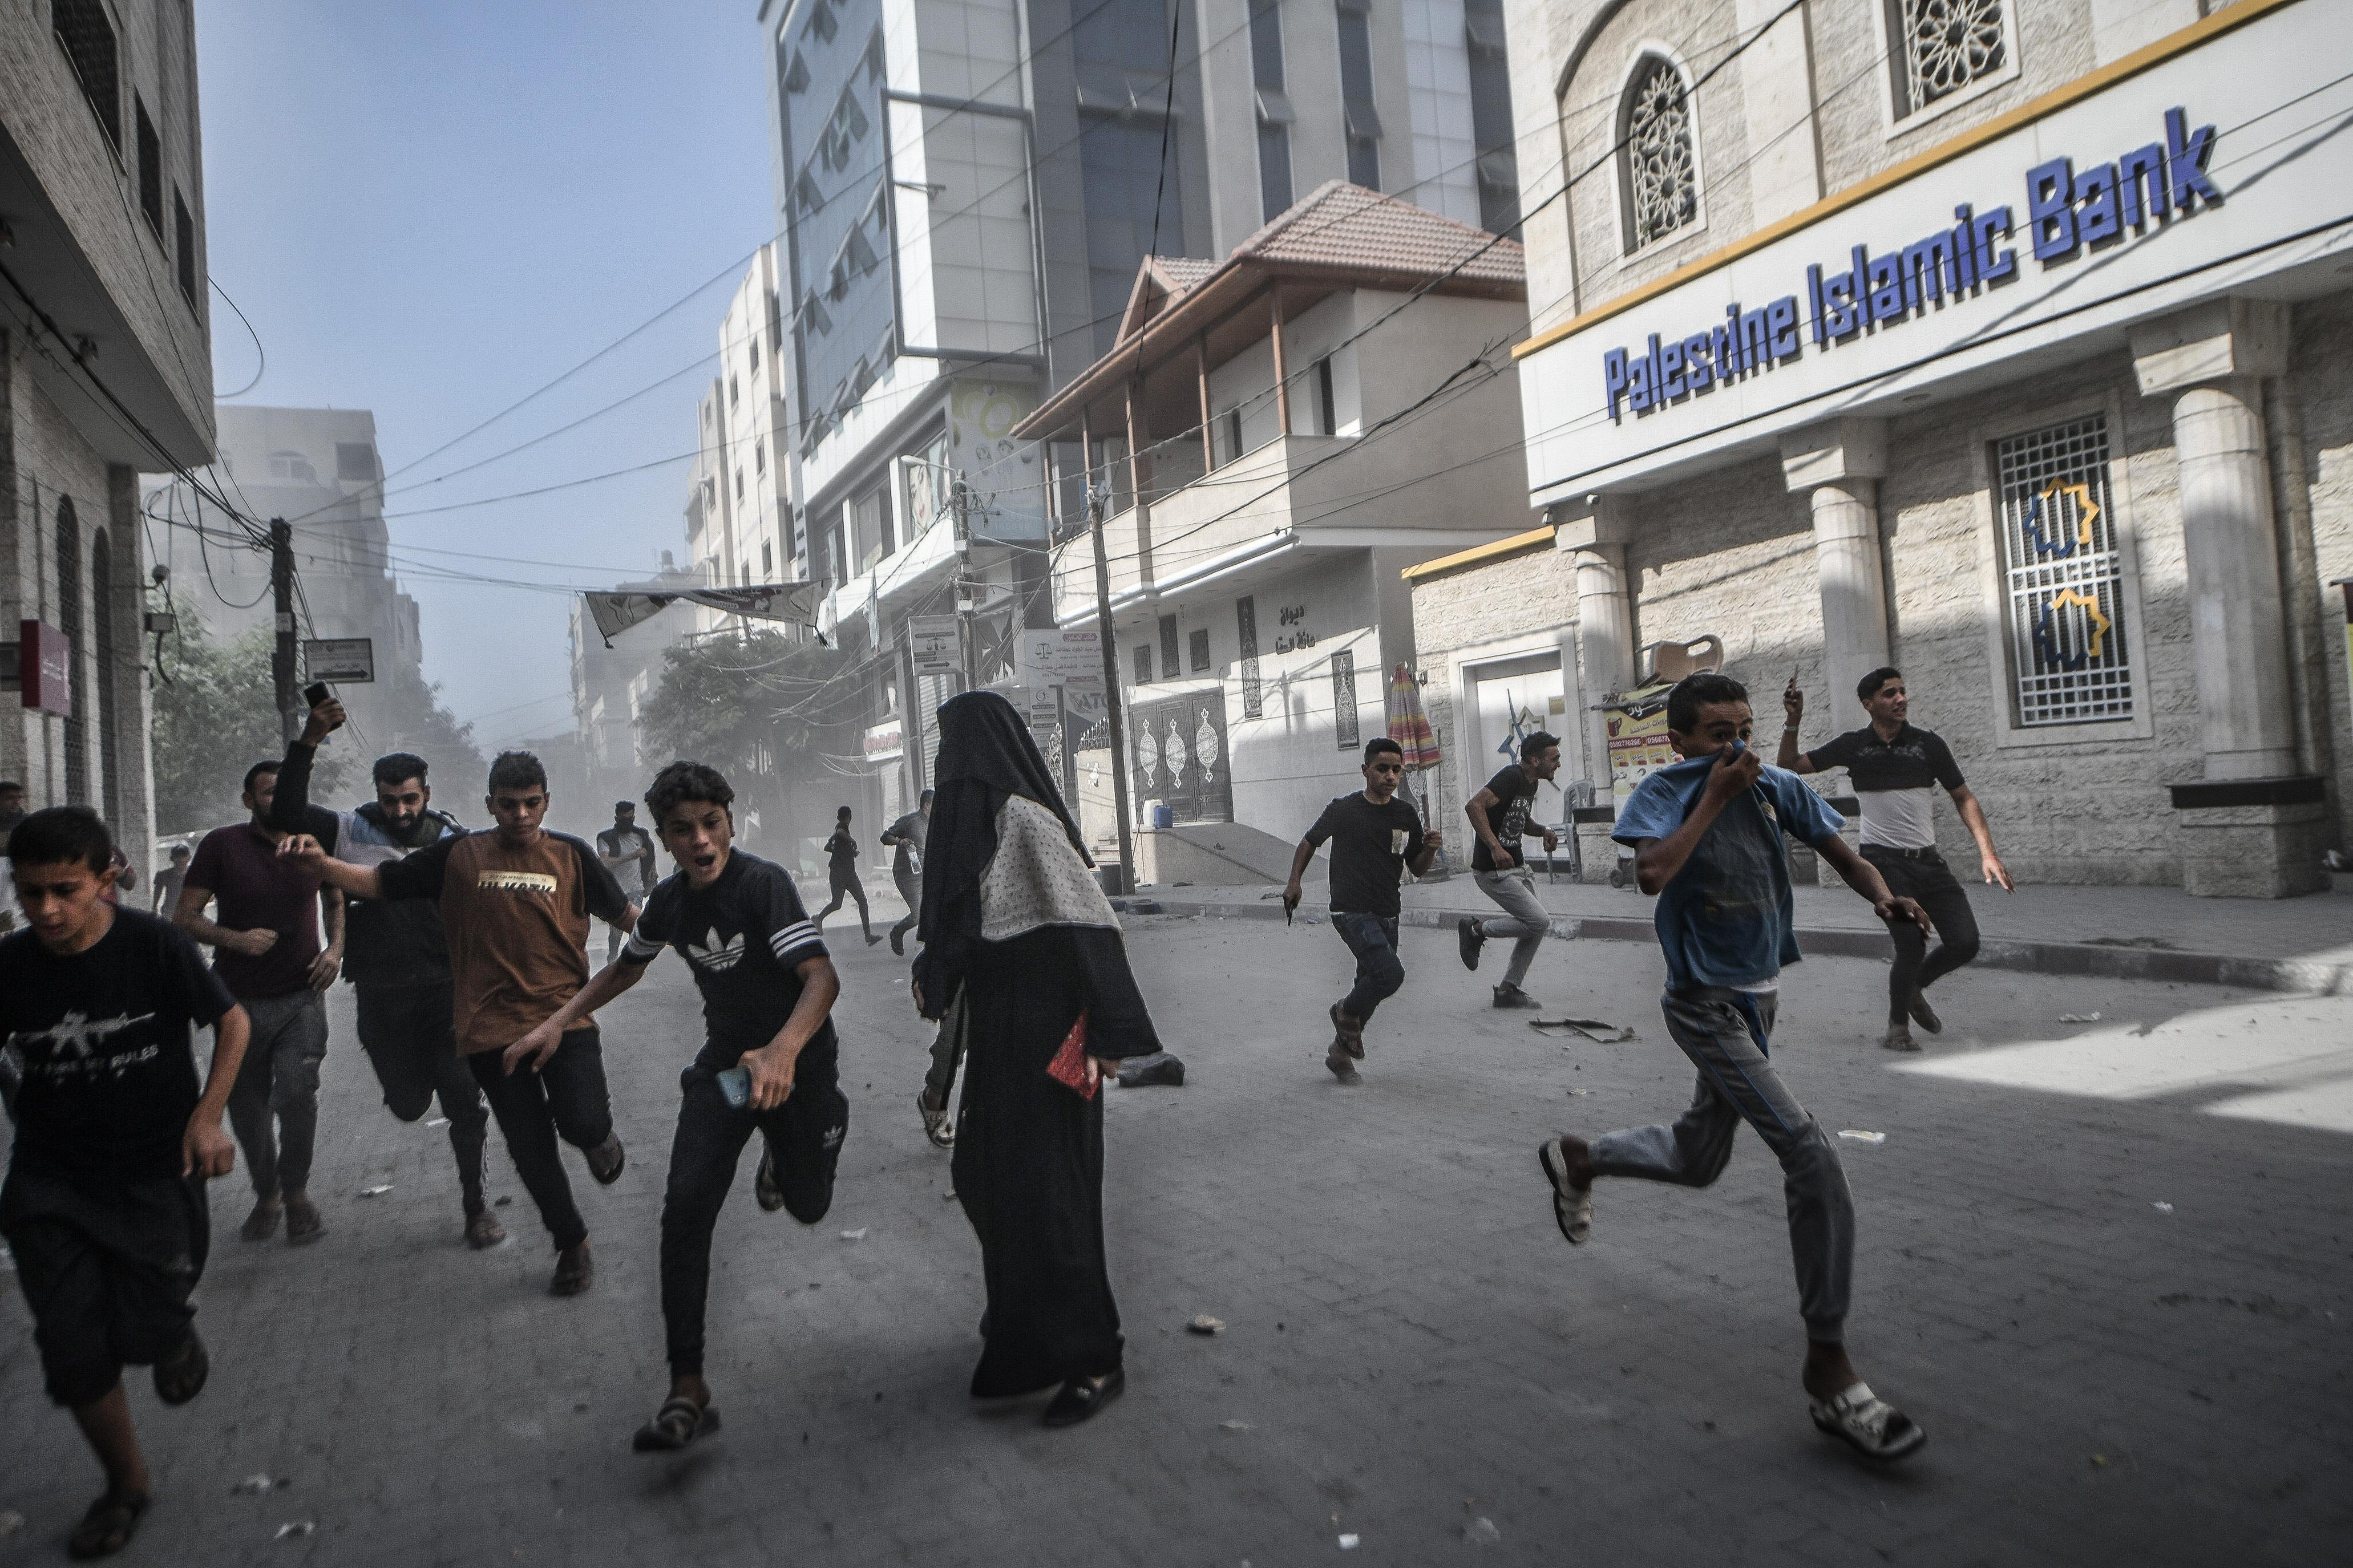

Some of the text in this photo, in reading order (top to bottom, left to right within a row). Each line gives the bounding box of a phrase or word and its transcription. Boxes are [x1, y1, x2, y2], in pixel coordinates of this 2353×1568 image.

[1604, 105, 2227, 424] Palestine Islamic Bank
[1280, 605, 1304, 626] ديوان
